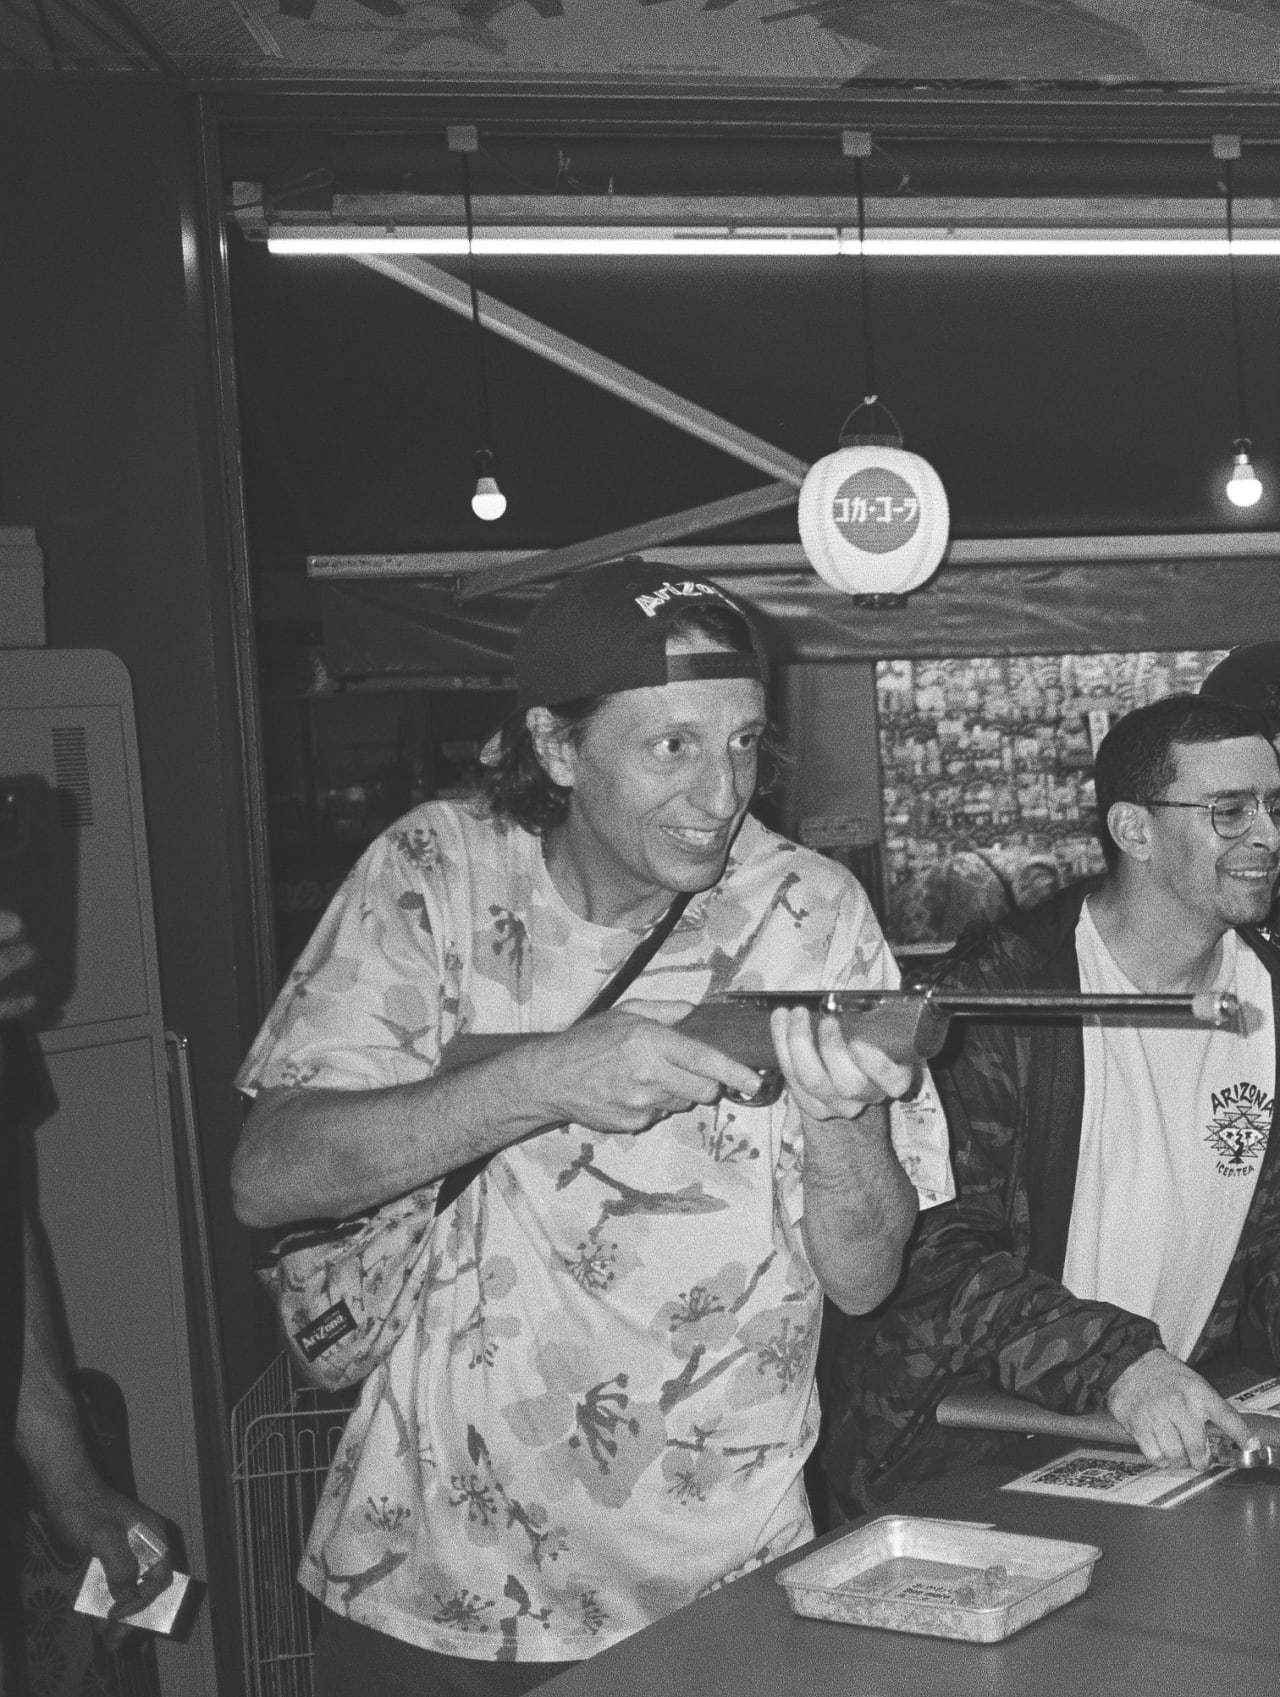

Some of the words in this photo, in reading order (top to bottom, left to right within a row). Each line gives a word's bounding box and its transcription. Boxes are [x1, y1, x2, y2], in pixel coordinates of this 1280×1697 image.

[834, 496, 919, 524] コカ・コーラ
[1210, 1082, 1275, 1118] ARIZONA
